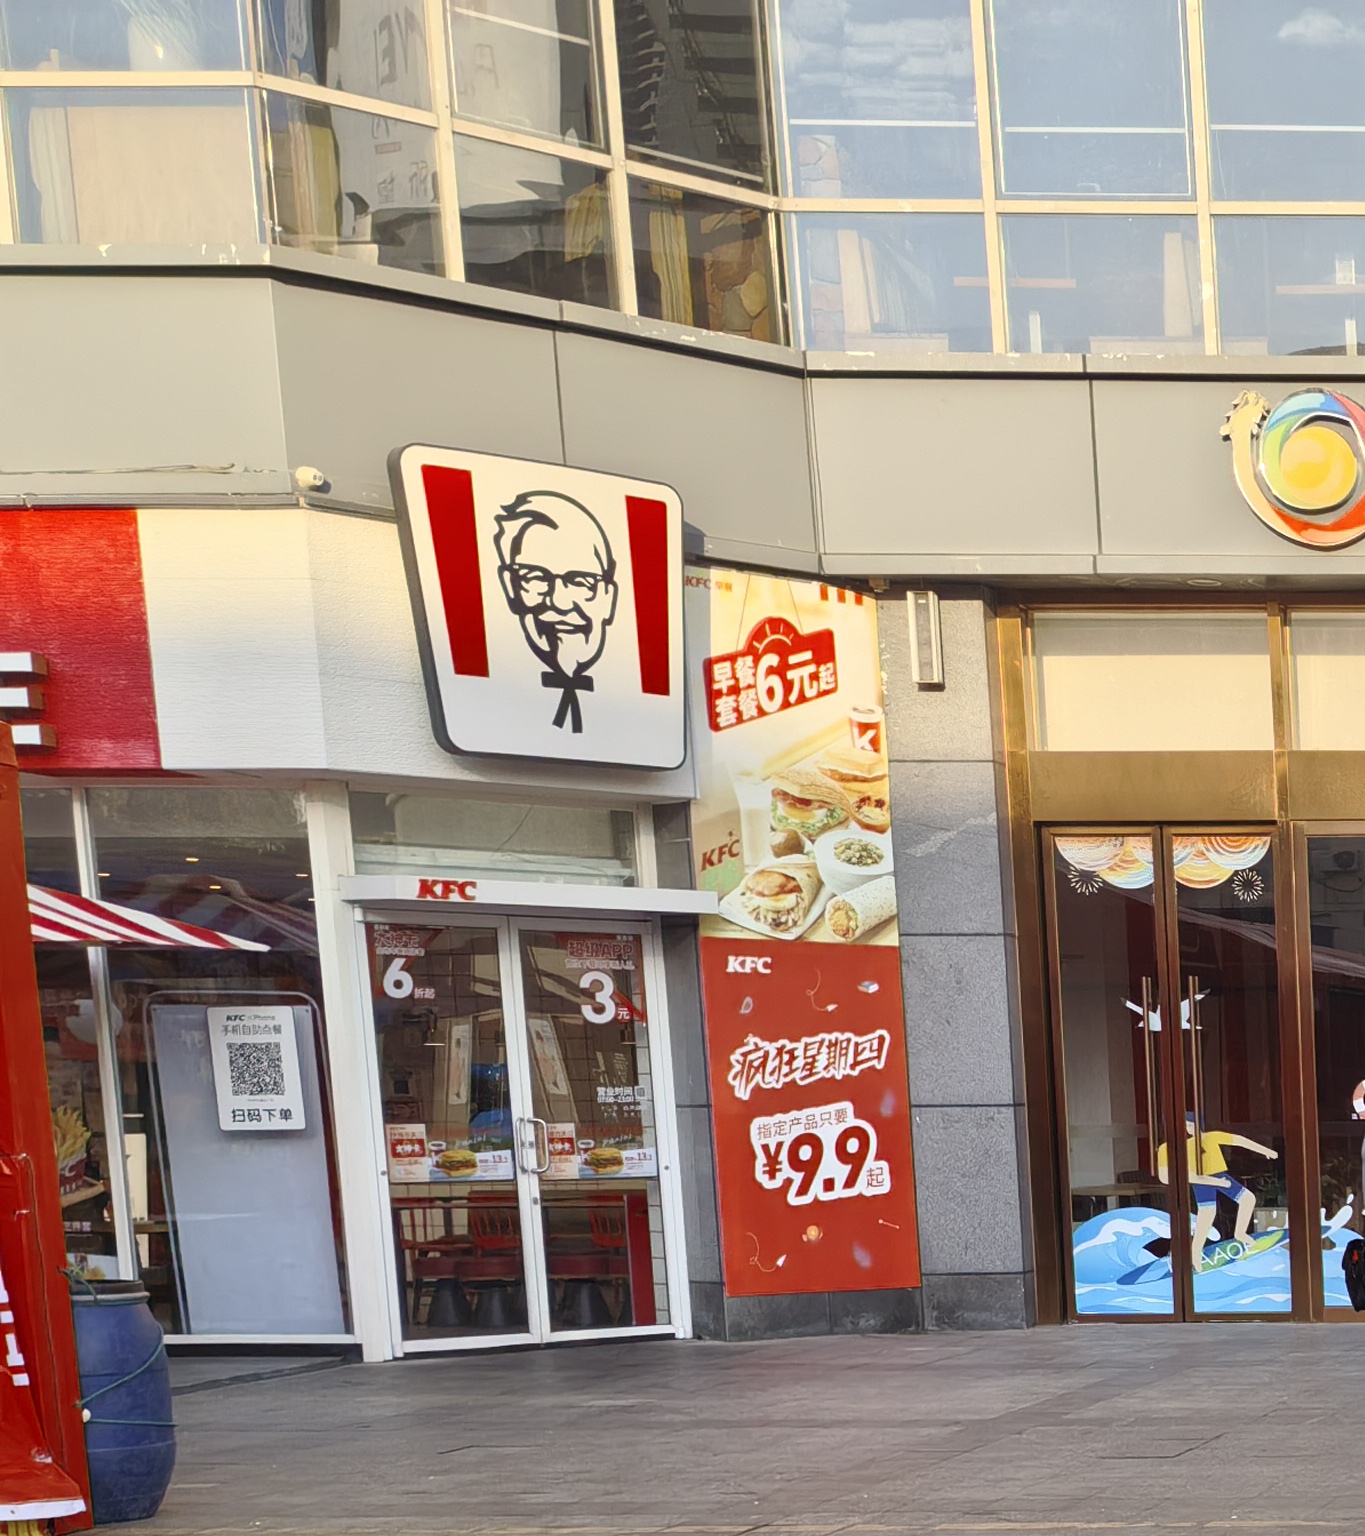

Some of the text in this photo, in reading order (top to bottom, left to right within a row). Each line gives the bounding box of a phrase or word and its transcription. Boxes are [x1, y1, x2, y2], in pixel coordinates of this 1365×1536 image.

[701, 839, 740, 872] KFC
[416, 879, 477, 901] KFC
[726, 956, 772, 973] KFC
[731, 1033, 887, 1097] 疯狂星期四
[231, 1108, 293, 1122] 扫码下单
[756, 1107, 848, 1141] 指定产品只要
